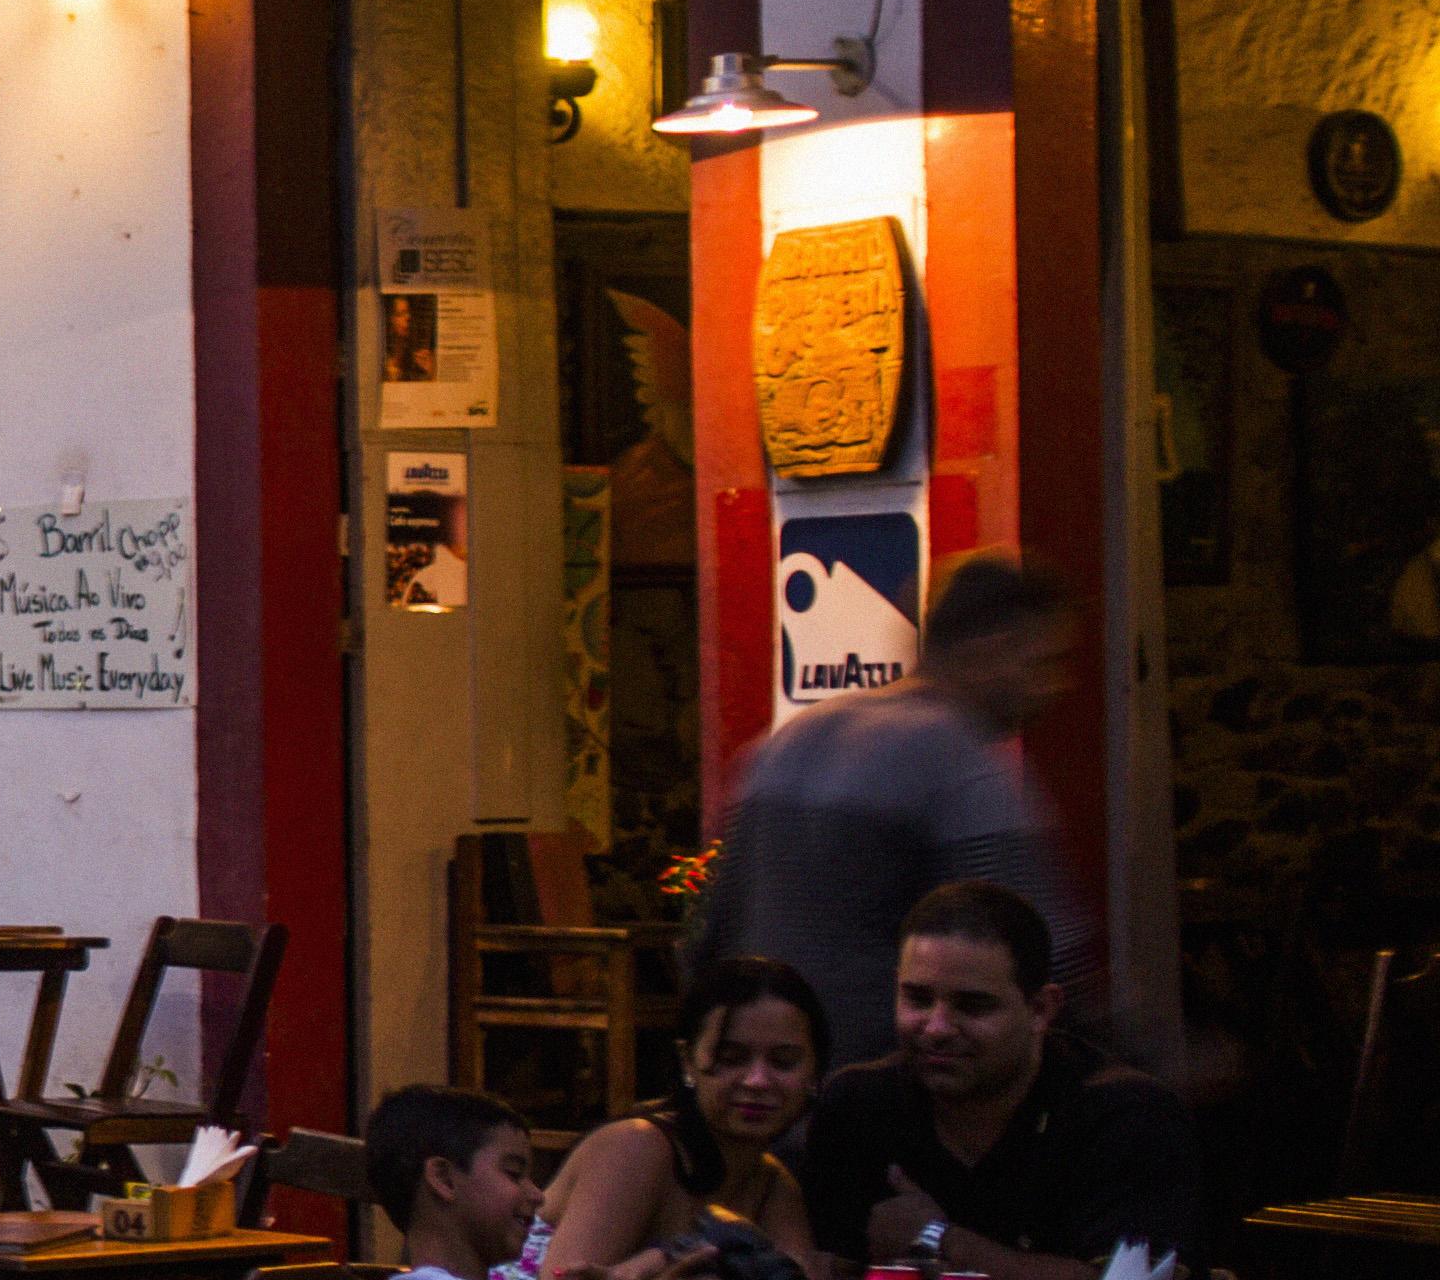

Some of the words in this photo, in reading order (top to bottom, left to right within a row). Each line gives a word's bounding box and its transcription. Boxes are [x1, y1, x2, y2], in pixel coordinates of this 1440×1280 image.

[38, 509, 112, 558] Barril
[76, 568, 100, 610] Ao
[108, 567, 146, 611] Vivo
[109, 616, 150, 642] Dias
[38, 651, 94, 692] Music
[98, 652, 184, 703] Everyday
[800, 651, 903, 691] LAVAZZA
[114, 1209, 146, 1235] 04
